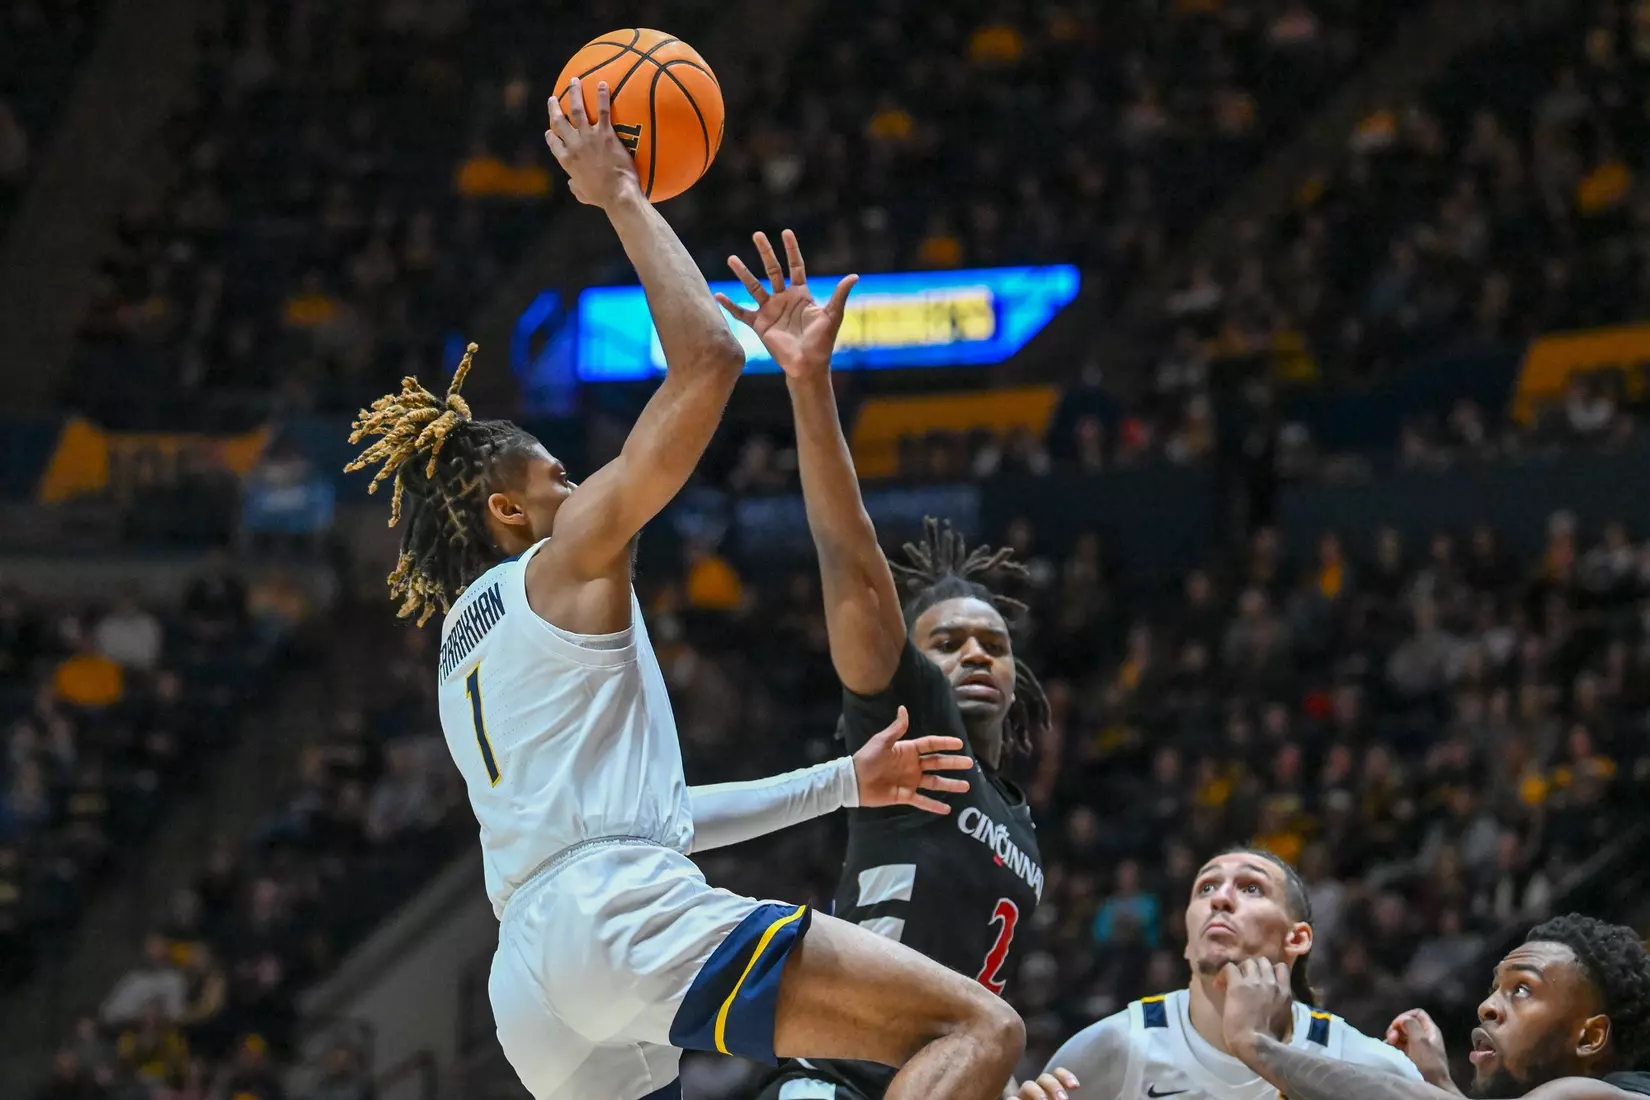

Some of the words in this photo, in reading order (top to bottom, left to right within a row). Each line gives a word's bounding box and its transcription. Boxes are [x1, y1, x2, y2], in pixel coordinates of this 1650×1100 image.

[465, 660, 502, 788] 1
[957, 806, 1045, 906] CINCINNA
[976, 897, 1020, 996] 2
